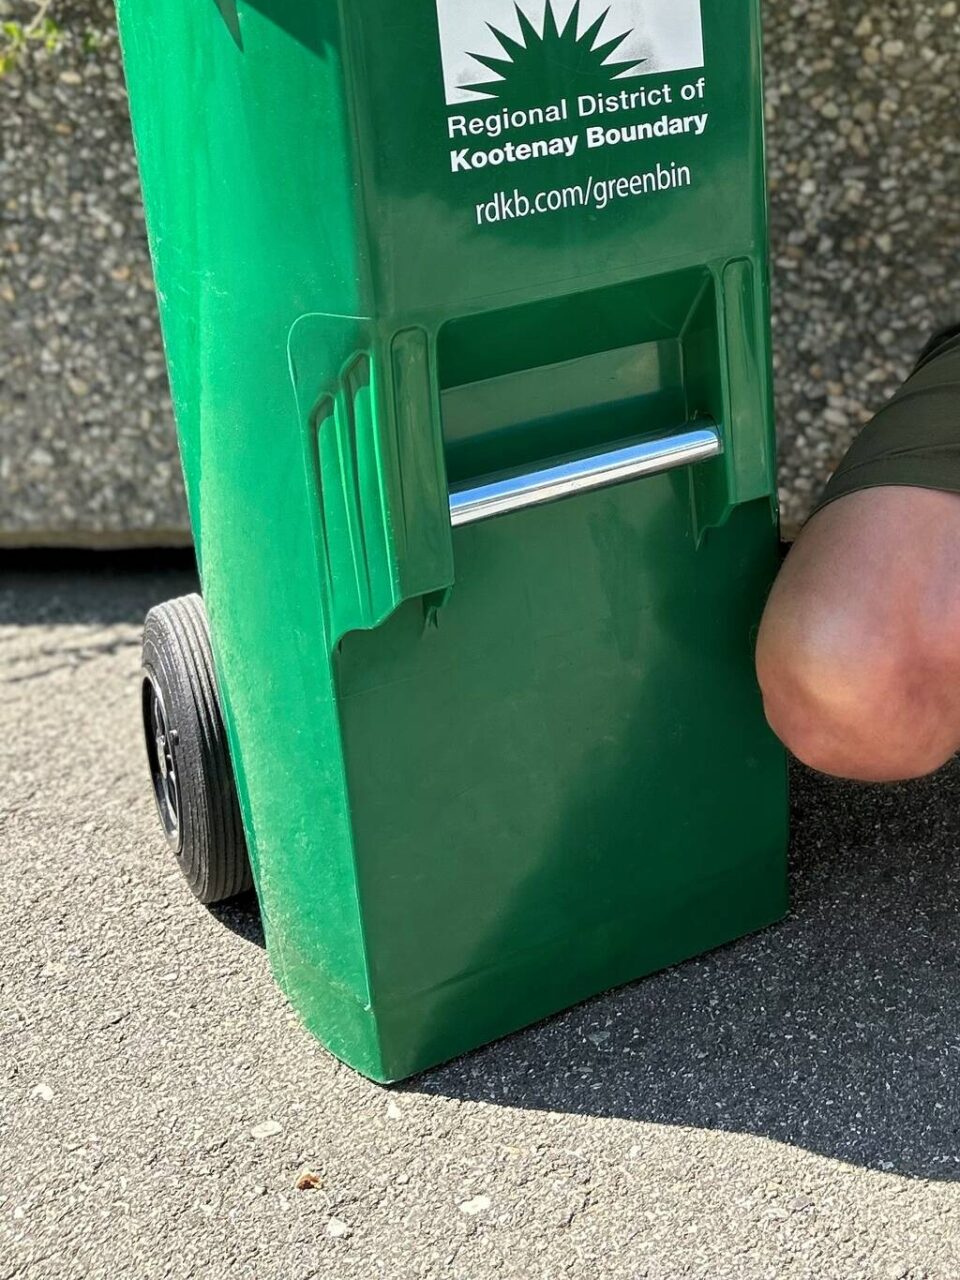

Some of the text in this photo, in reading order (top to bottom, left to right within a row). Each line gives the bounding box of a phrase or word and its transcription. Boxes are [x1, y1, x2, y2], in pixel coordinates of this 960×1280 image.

[447, 77, 706, 139] Regional District of
[449, 113, 709, 173] Kootenay Boundary
[474, 160, 692, 225] rdkb.com/greenbin
